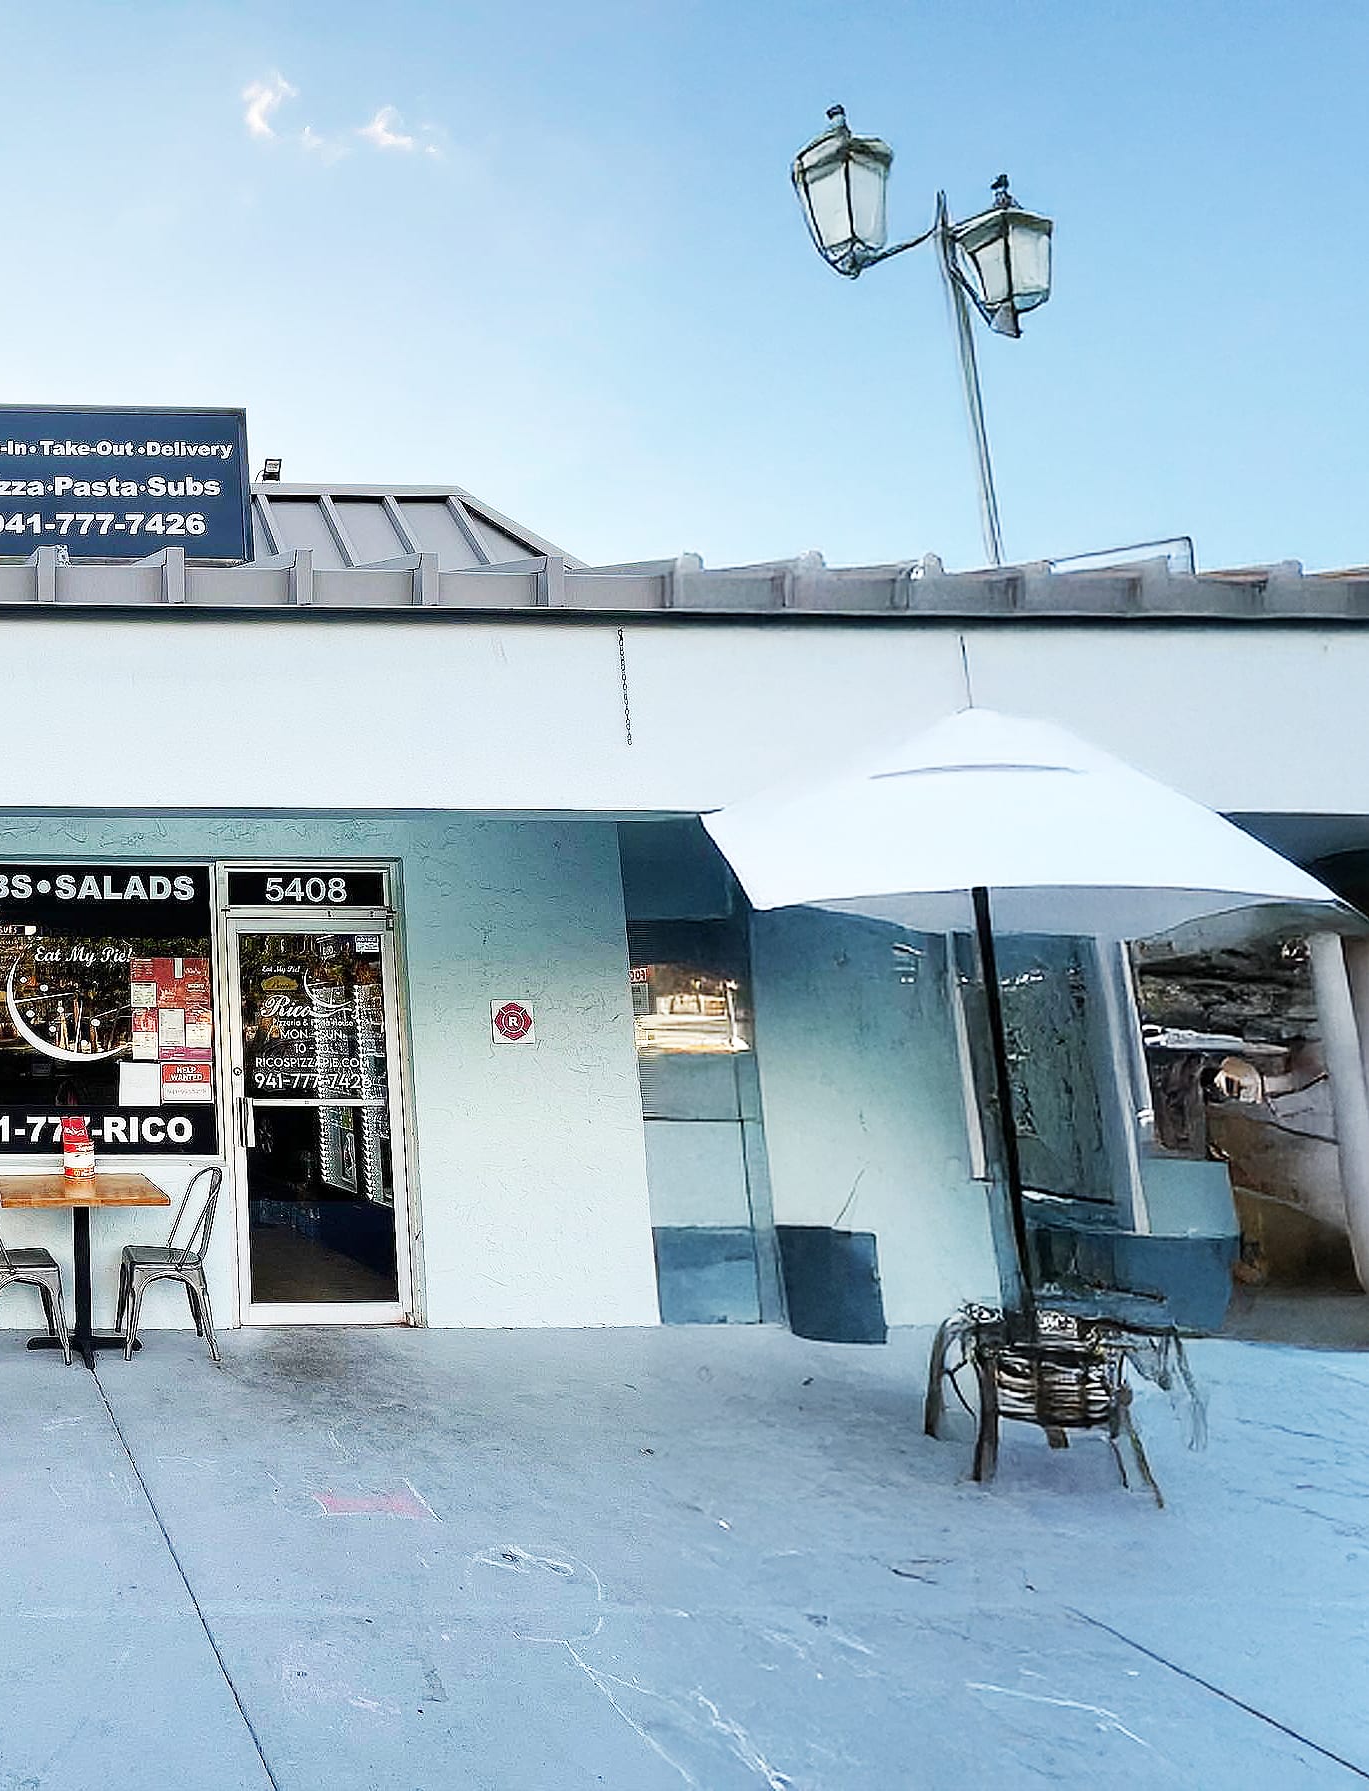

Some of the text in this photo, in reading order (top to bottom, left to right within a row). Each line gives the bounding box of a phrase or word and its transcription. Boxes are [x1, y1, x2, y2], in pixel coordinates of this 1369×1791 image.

[40, 440, 135, 456] Take-Out
[146, 440, 233, 459] Delivery
[54, 476, 138, 497] Pasta
[147, 477, 221, 497] Subs
[55, 875, 195, 900] SALADS
[265, 877, 347, 902] 5408
[34, 946, 133, 967] Eat My Pie!
[281, 1029, 308, 1039] MON
[295, 1043, 307, 1054] 10
[170, 1073, 203, 1081] WANTED
